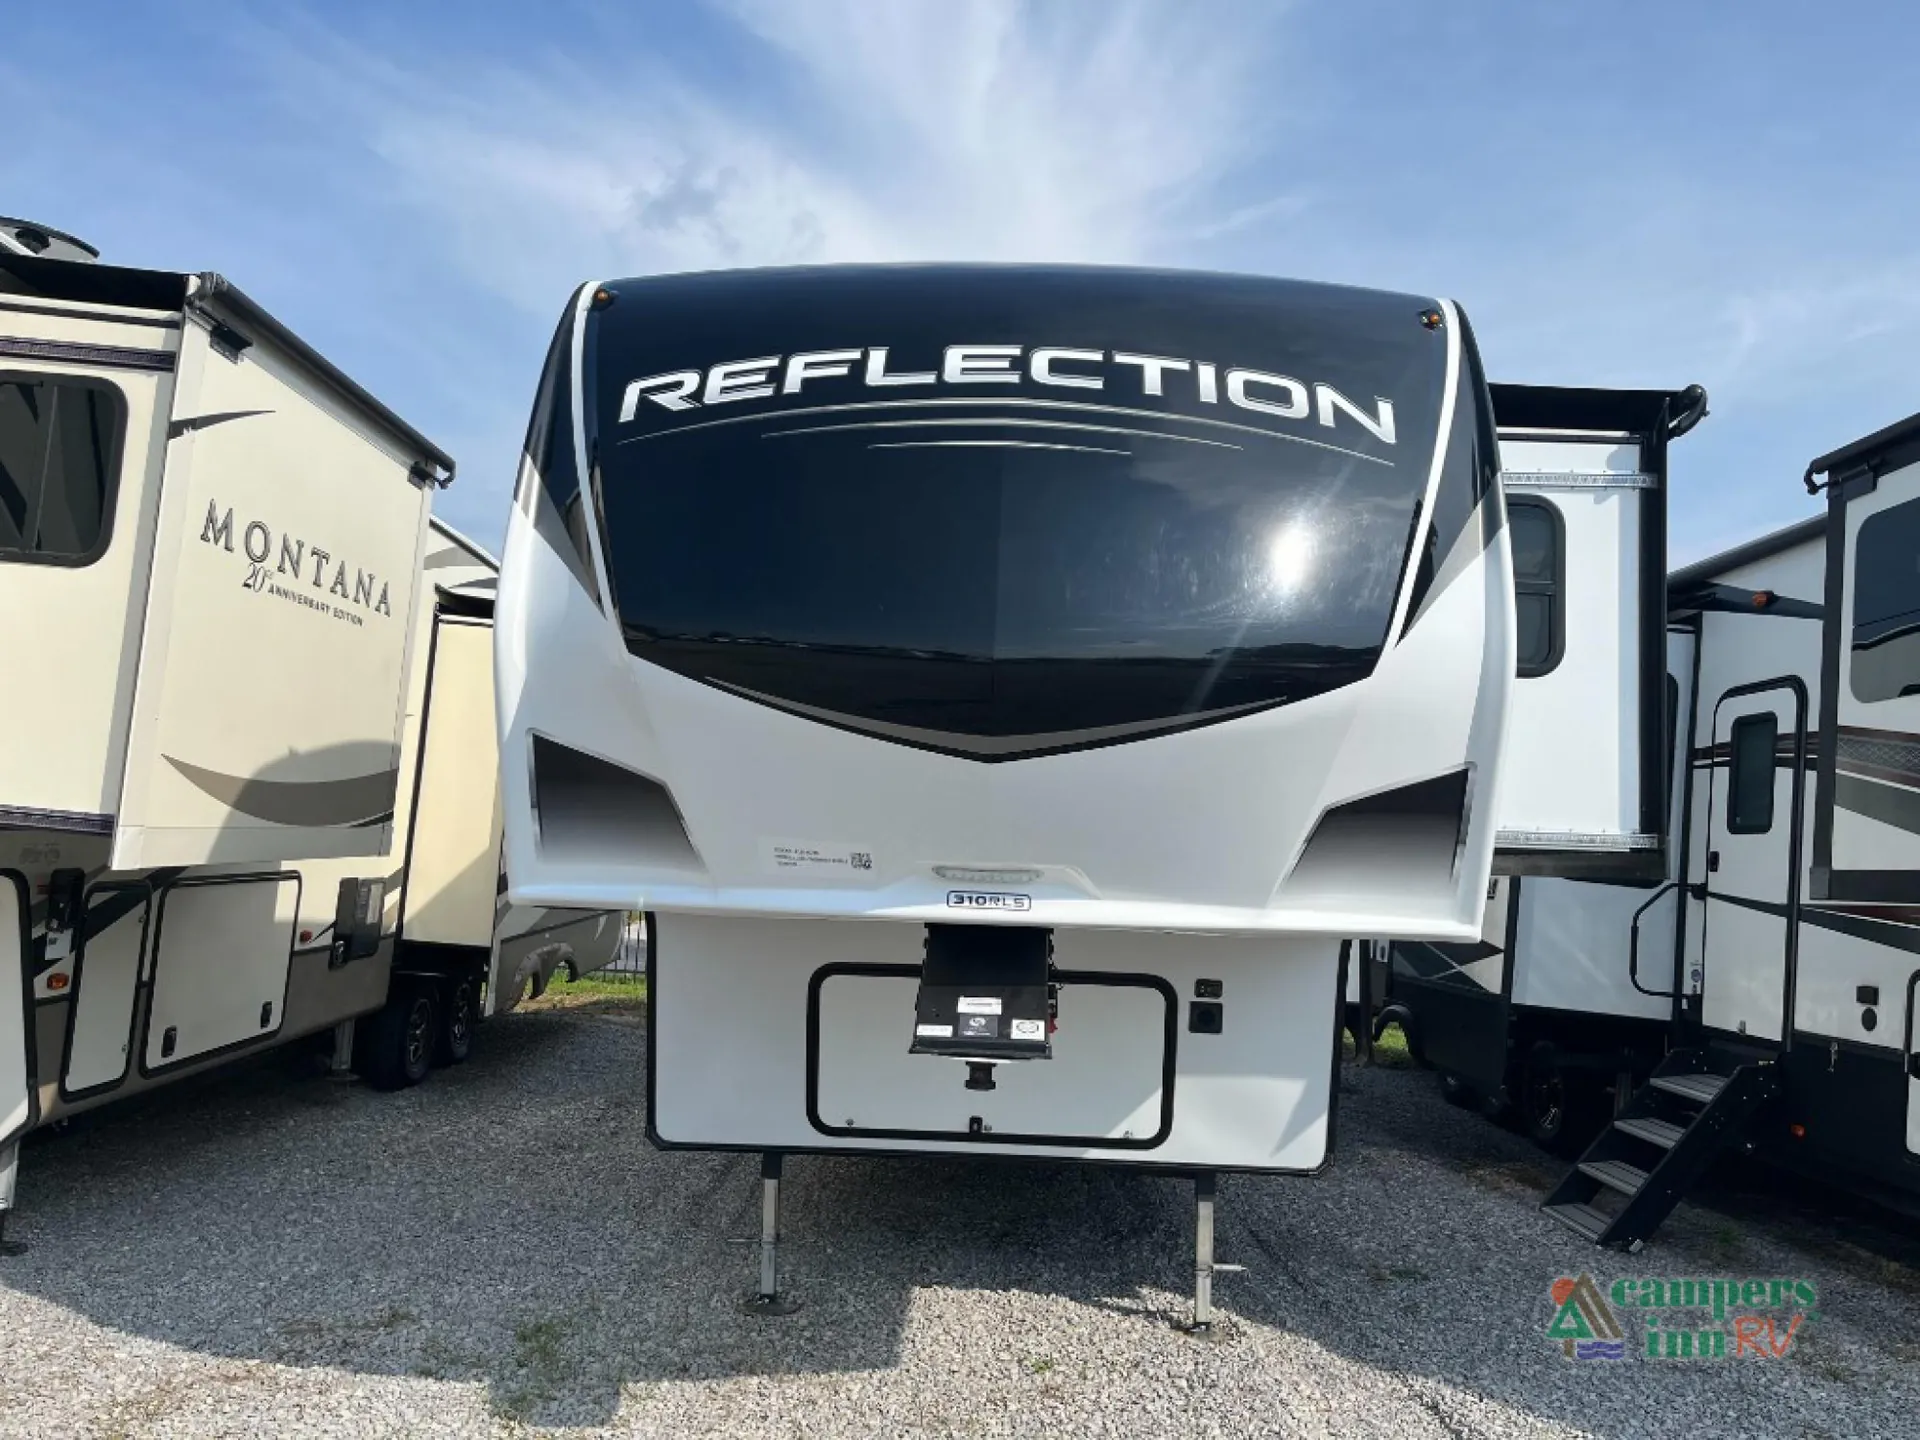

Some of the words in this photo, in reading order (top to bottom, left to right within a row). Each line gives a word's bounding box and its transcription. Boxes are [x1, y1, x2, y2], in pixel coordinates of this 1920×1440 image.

[618, 343, 1396, 444] REFLECTION
[199, 498, 391, 618] MONTANA
[267, 583, 330, 614] ANNIVERSARY
[333, 607, 363, 627] EDITION
[953, 894, 1025, 908] 310RLS
